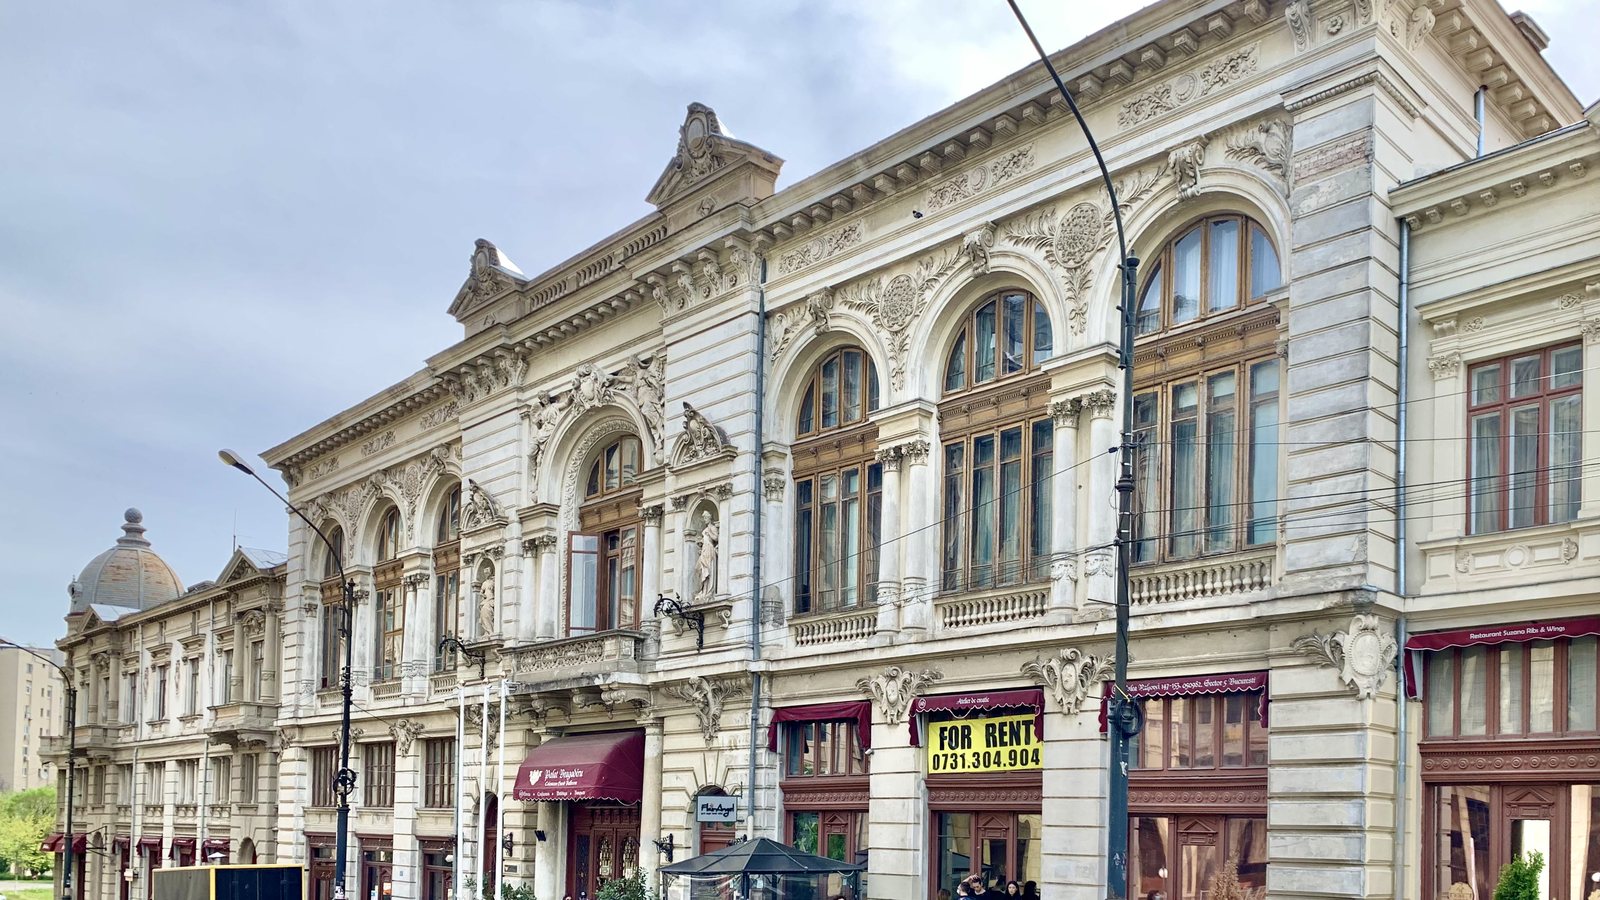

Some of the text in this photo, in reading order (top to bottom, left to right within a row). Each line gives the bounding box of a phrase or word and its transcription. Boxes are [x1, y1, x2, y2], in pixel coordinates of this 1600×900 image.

[1469, 631, 1502, 640] Restaurant
[1546, 625, 1565, 633] Wings
[939, 719, 1034, 751] FOR RENT
[932, 748, 1040, 770] 0731.304.904
